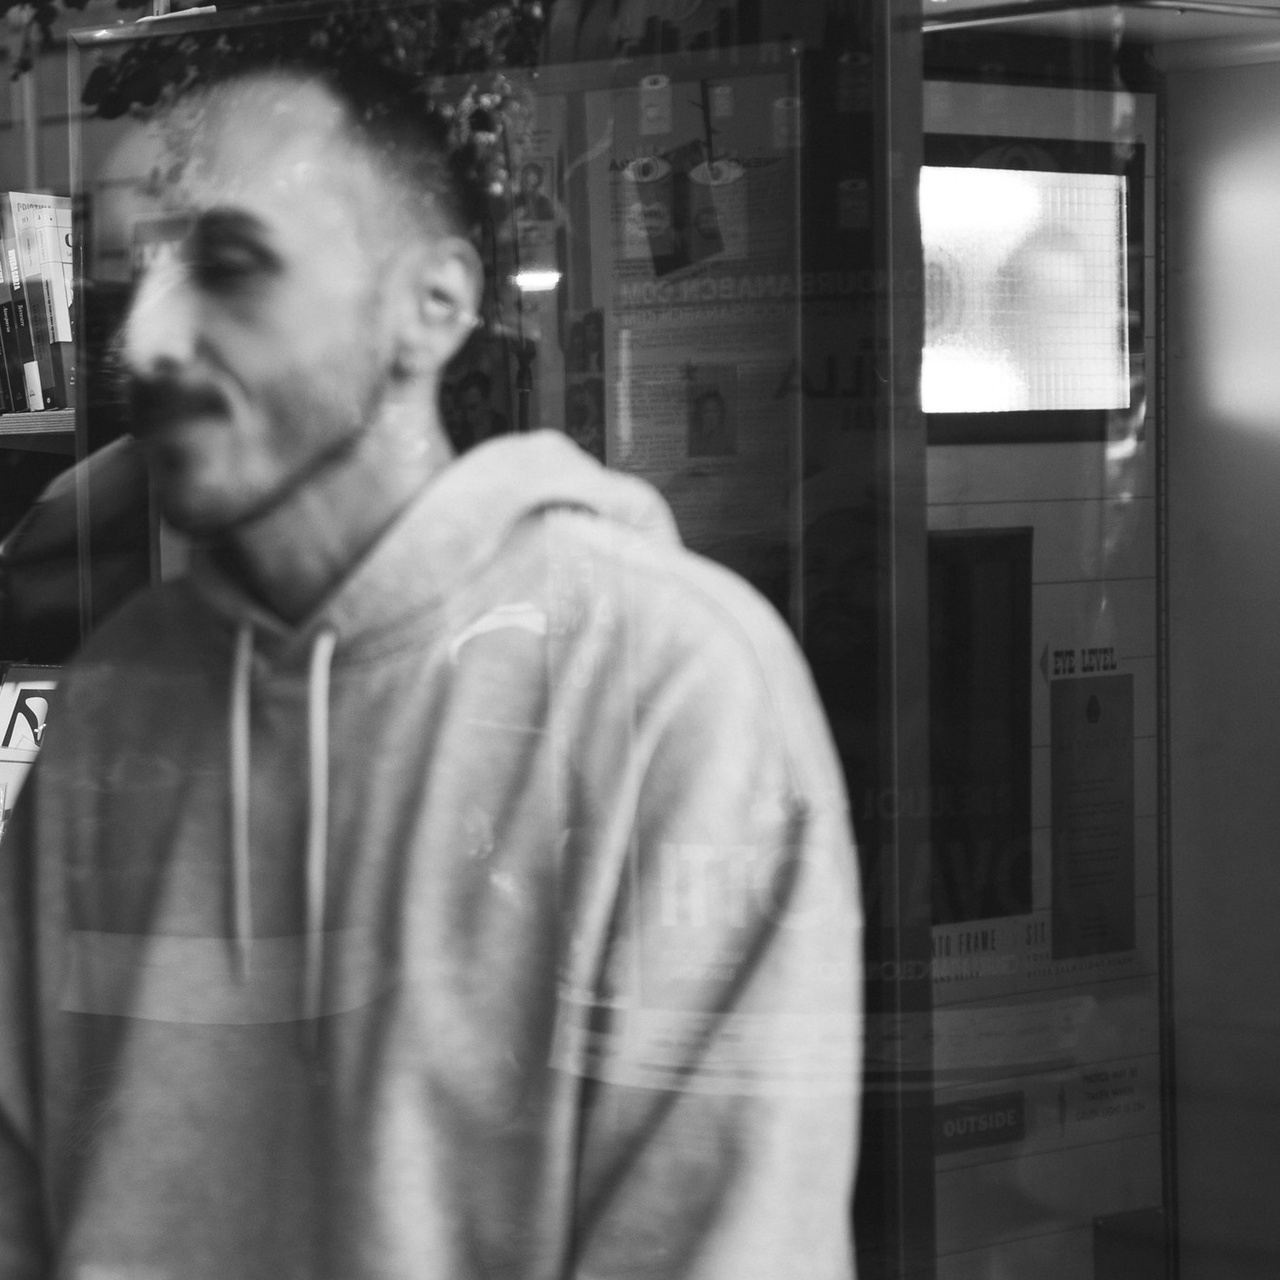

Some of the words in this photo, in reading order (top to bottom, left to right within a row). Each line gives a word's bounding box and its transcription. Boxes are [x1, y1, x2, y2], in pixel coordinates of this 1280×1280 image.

[1054, 649, 1076, 675] EYE
[1081, 646, 1118, 673] LEVEL
[959, 929, 997, 954] FRAME
[943, 1108, 1017, 1137] OUTSIDE
